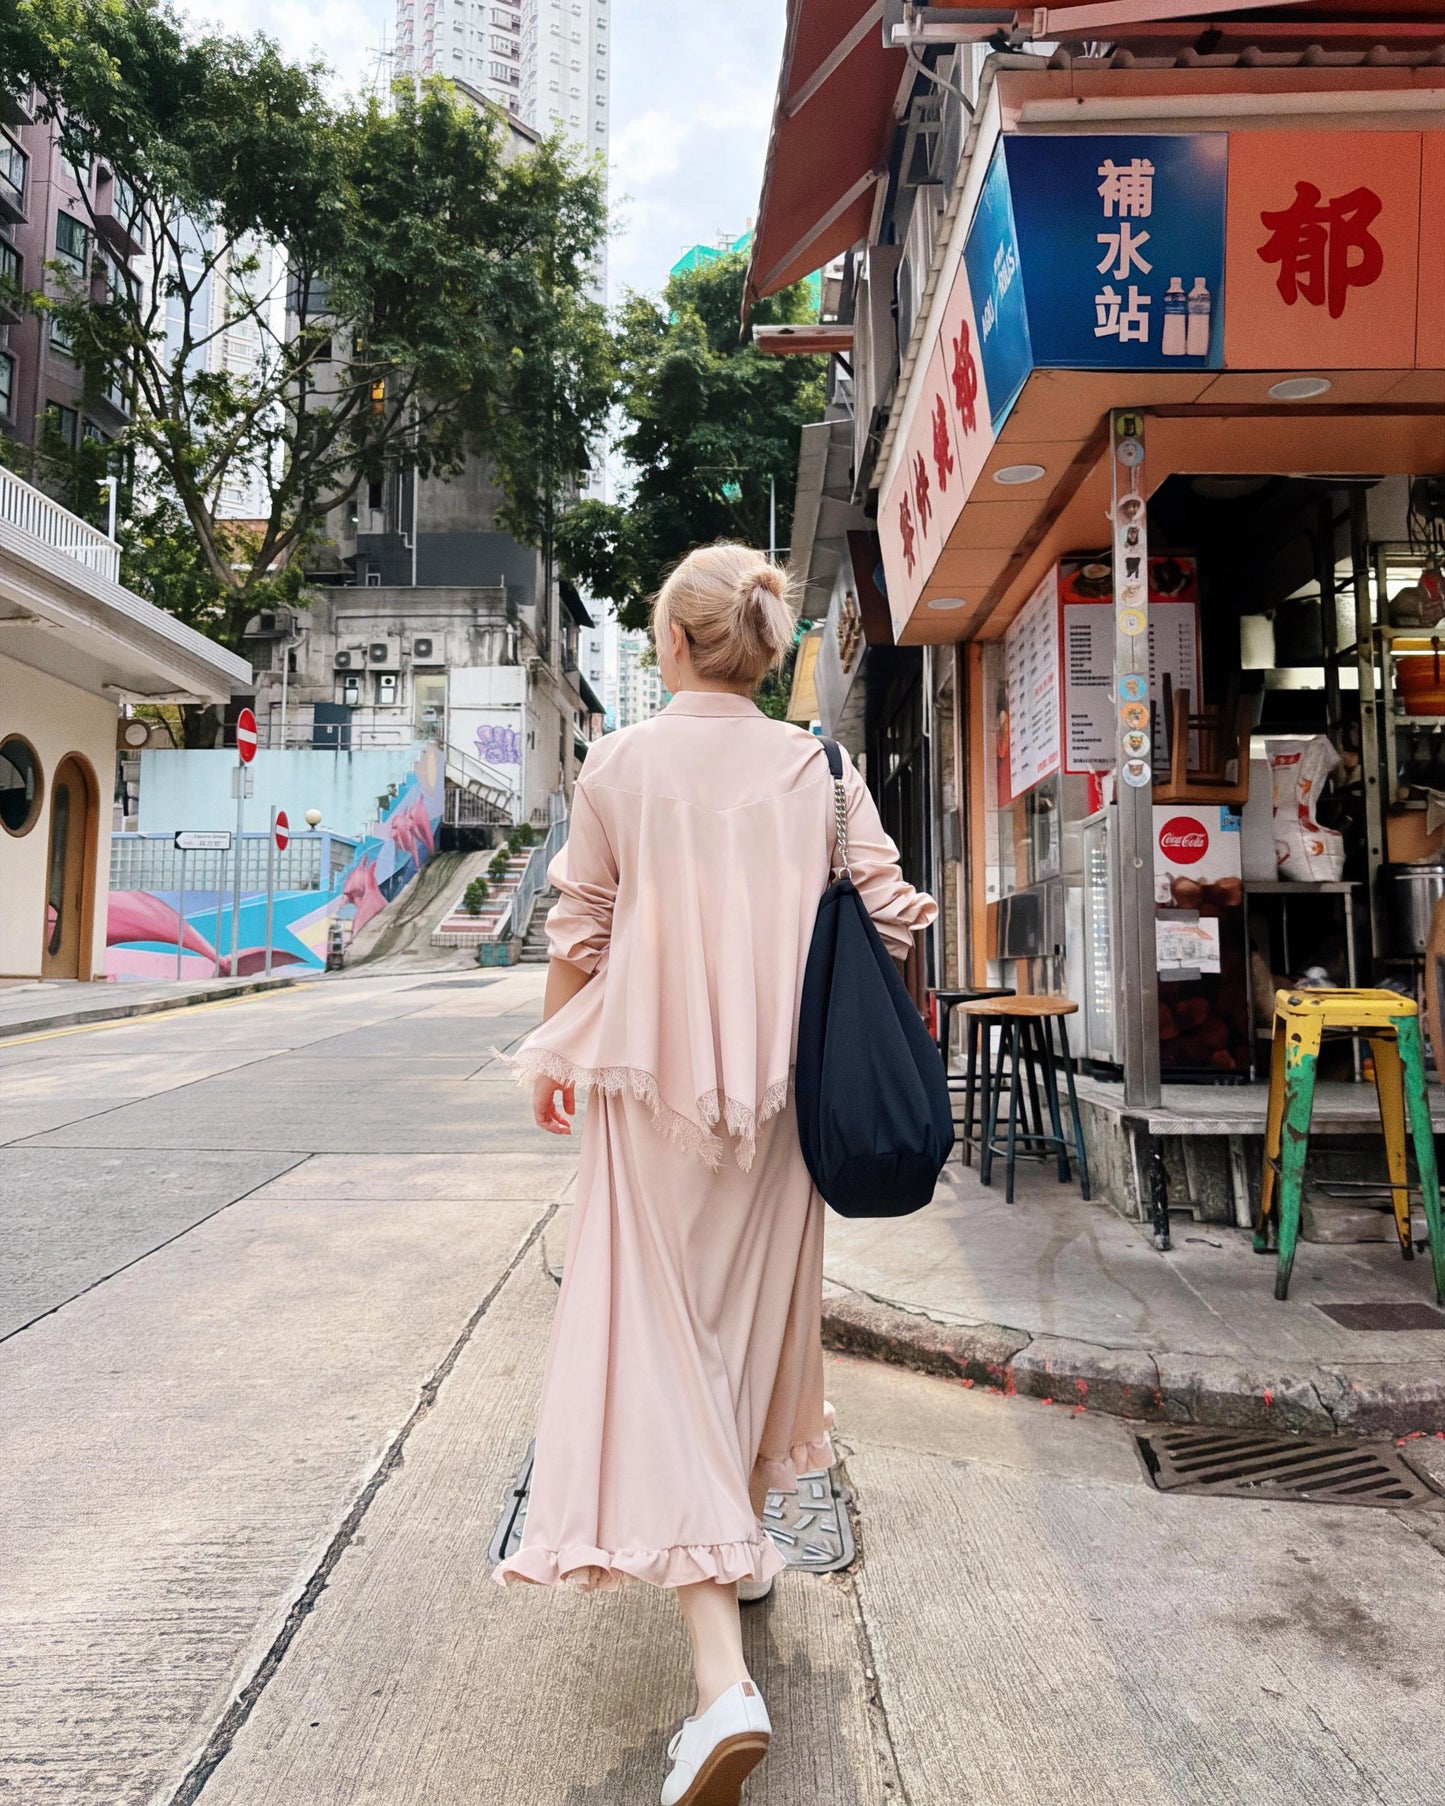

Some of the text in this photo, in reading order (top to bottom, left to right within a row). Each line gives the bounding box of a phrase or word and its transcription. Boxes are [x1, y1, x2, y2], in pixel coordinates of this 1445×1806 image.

[1093, 158, 1155, 342] 補水站
[1256, 181, 1383, 319] 郁
